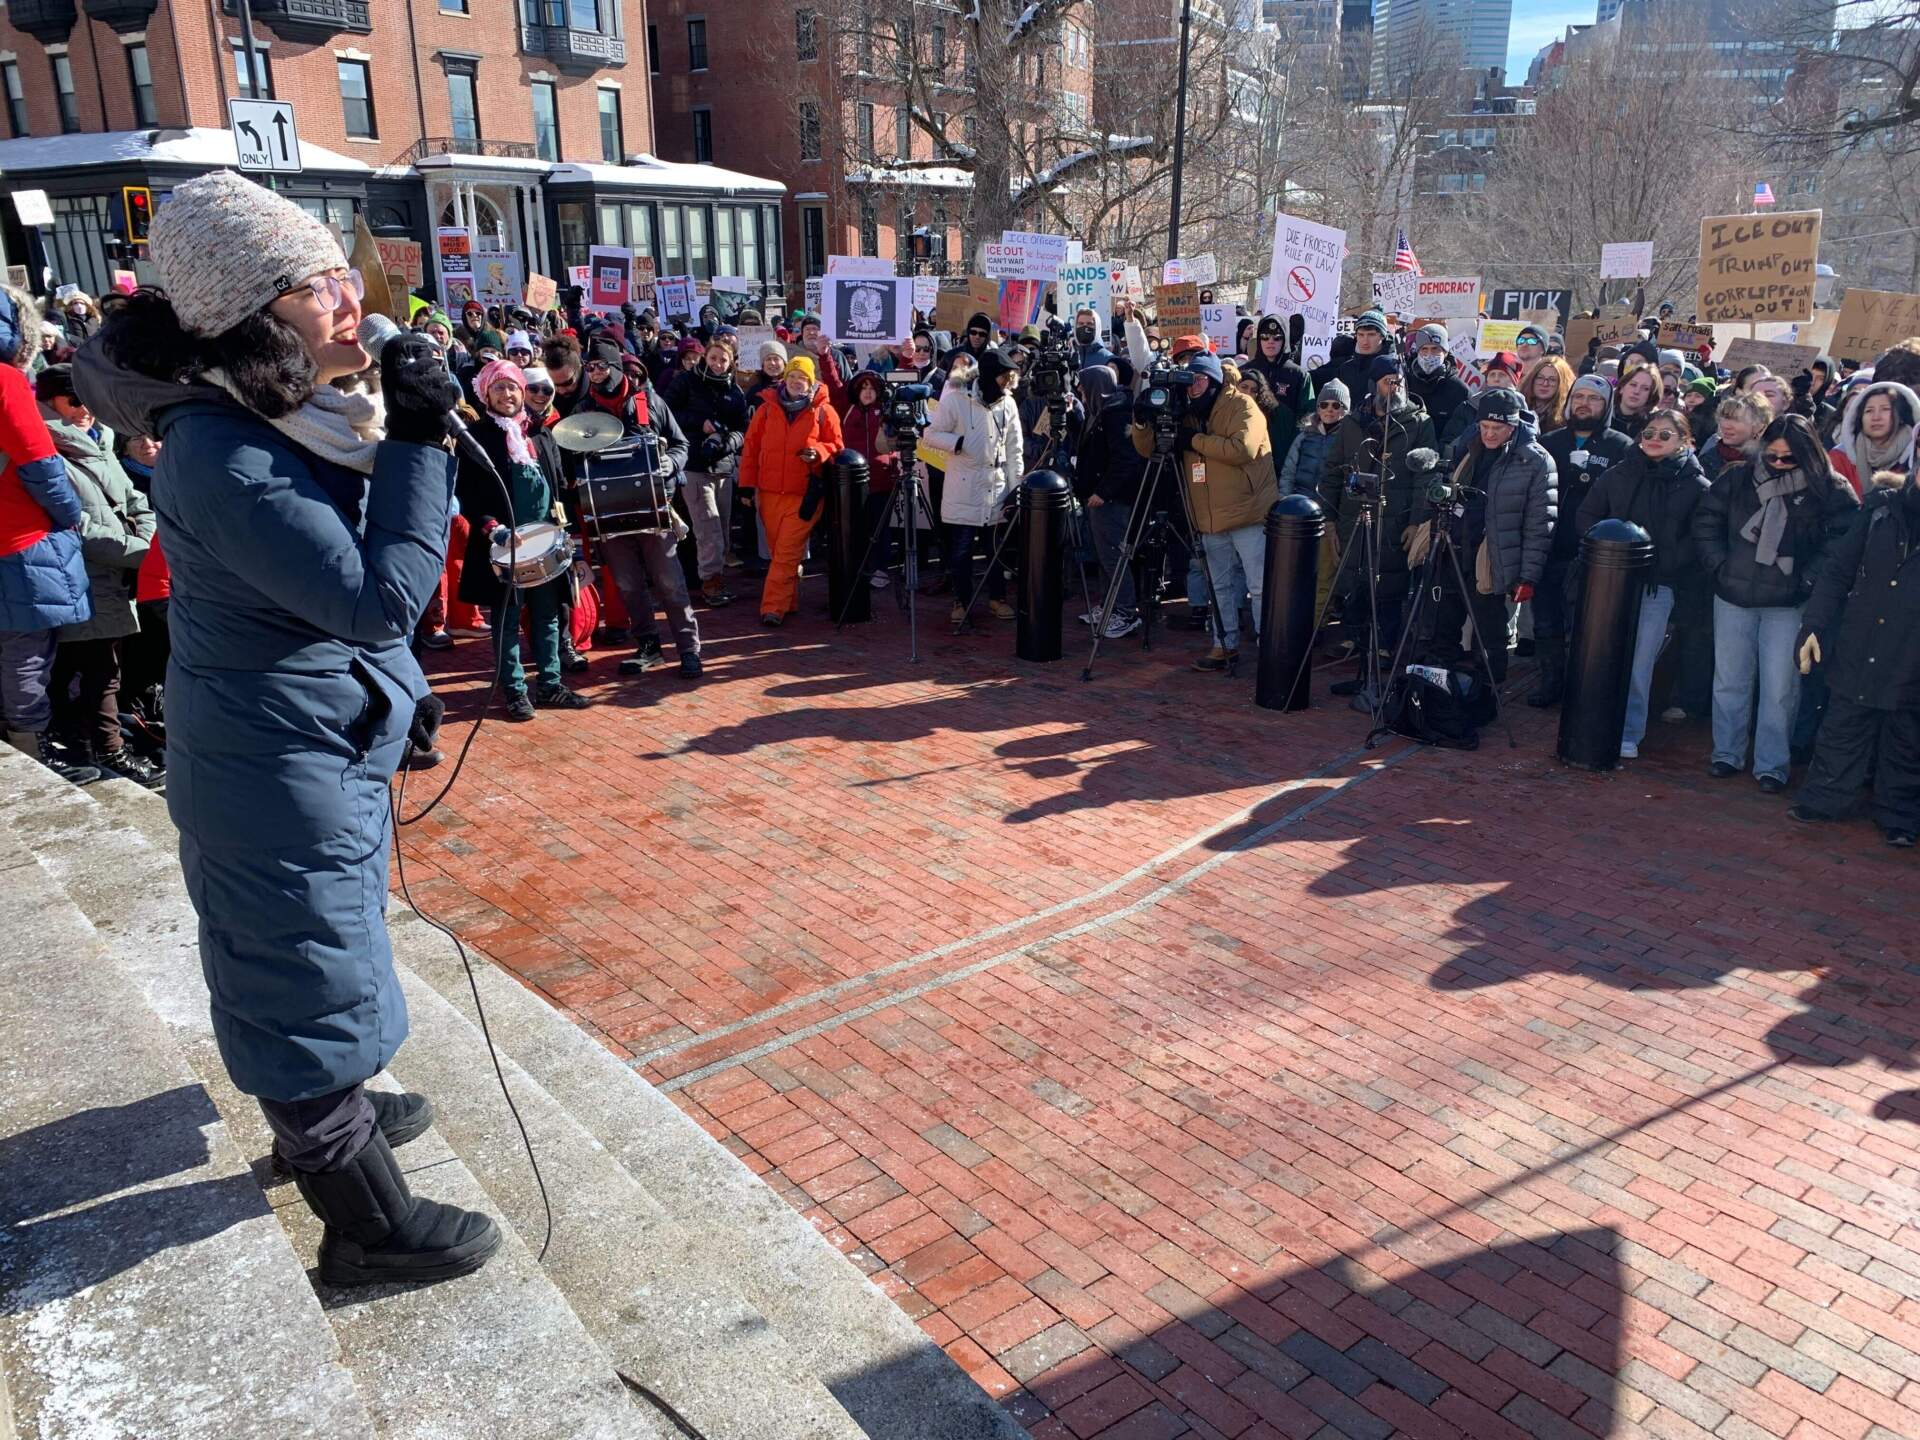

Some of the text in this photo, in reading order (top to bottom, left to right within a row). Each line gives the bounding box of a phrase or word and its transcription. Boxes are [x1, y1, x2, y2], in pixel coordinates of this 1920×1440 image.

[242, 153, 268, 165] ONLY
[1712, 217, 1816, 250] ICE OUT
[987, 246, 1002, 256] ICE
[1004, 247, 1024, 256] OUT
[1286, 227, 1340, 260] DUE PROCESS!
[379, 242, 420, 263] BOLISH
[1285, 245, 1336, 272] RULE OF LAW
[1709, 253, 1813, 276] TRUMP OUT
[1058, 267, 1107, 280] HANDS
[1066, 282, 1093, 296] OFF
[1382, 277, 1396, 292] HEY
[1419, 281, 1475, 295] DEMOCRACY
[1384, 286, 1400, 301] GET
[1068, 300, 1097, 315] ICE
[1393, 294, 1414, 311] ASS
[1502, 291, 1562, 316] FUCK
[1755, 299, 1793, 313] OUT
[1596, 324, 1619, 342] Fuck
[1845, 336, 1882, 351] ICE
